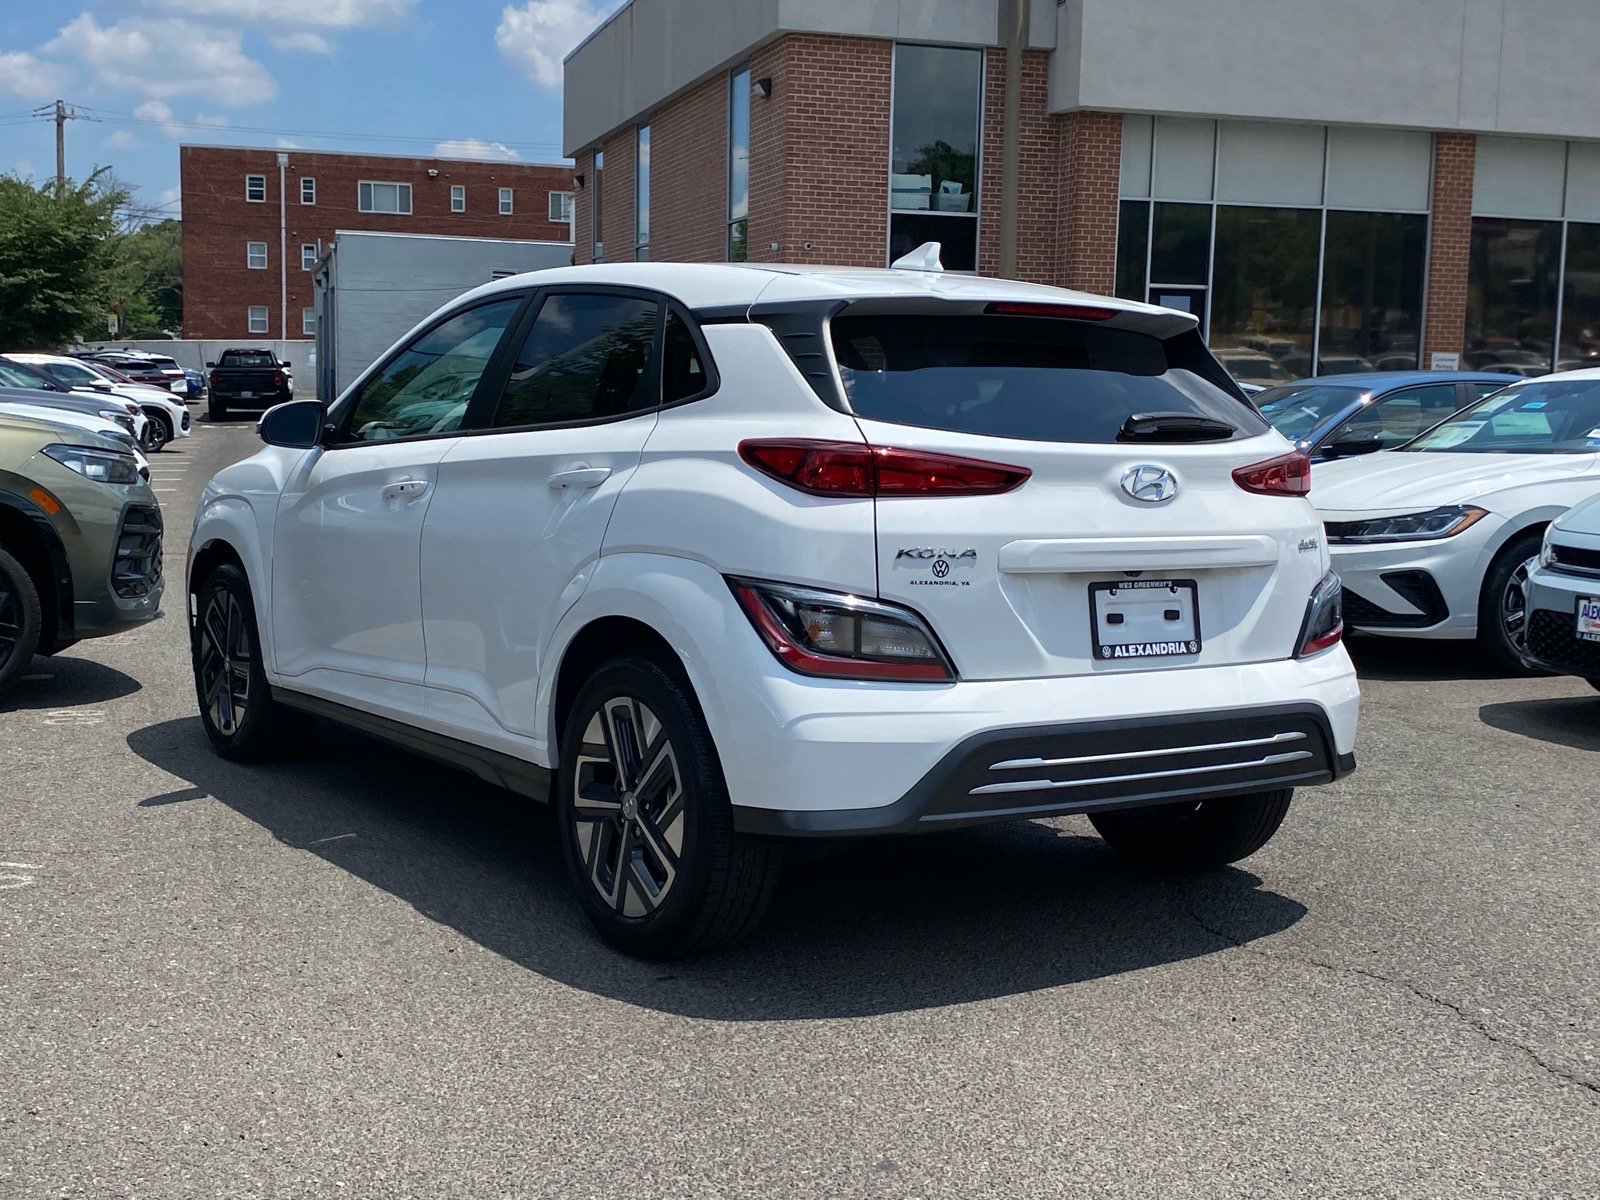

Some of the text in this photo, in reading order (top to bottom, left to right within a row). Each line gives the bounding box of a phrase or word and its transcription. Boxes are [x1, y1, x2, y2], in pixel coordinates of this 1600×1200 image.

[895, 547, 977, 559] KONA
[1133, 580, 1173, 588] GREENWAY'S
[1114, 642, 1187, 658] ALEXANDRIA
